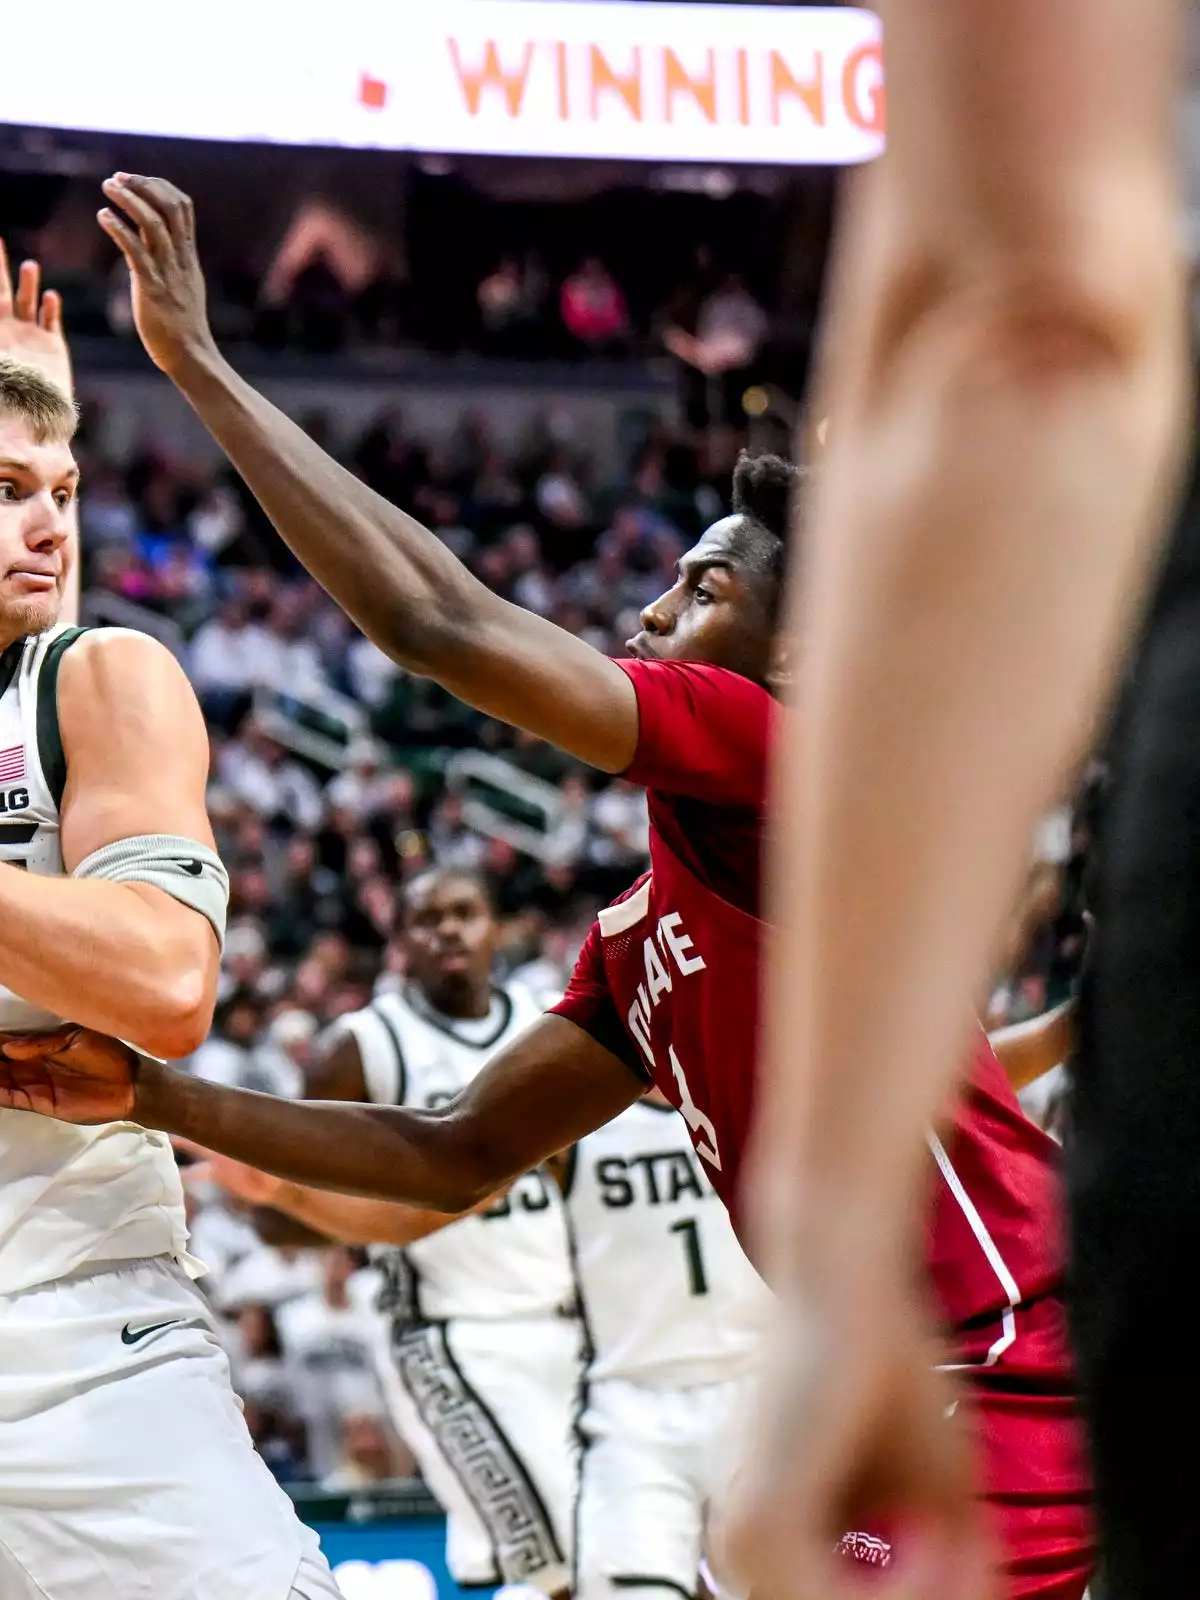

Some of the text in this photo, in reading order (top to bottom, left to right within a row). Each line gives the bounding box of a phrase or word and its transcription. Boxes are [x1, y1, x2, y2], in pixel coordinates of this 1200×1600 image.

[446, 37, 886, 134] WINNING
[595, 1151, 718, 1208] STA
[668, 1215, 708, 1296] 1
